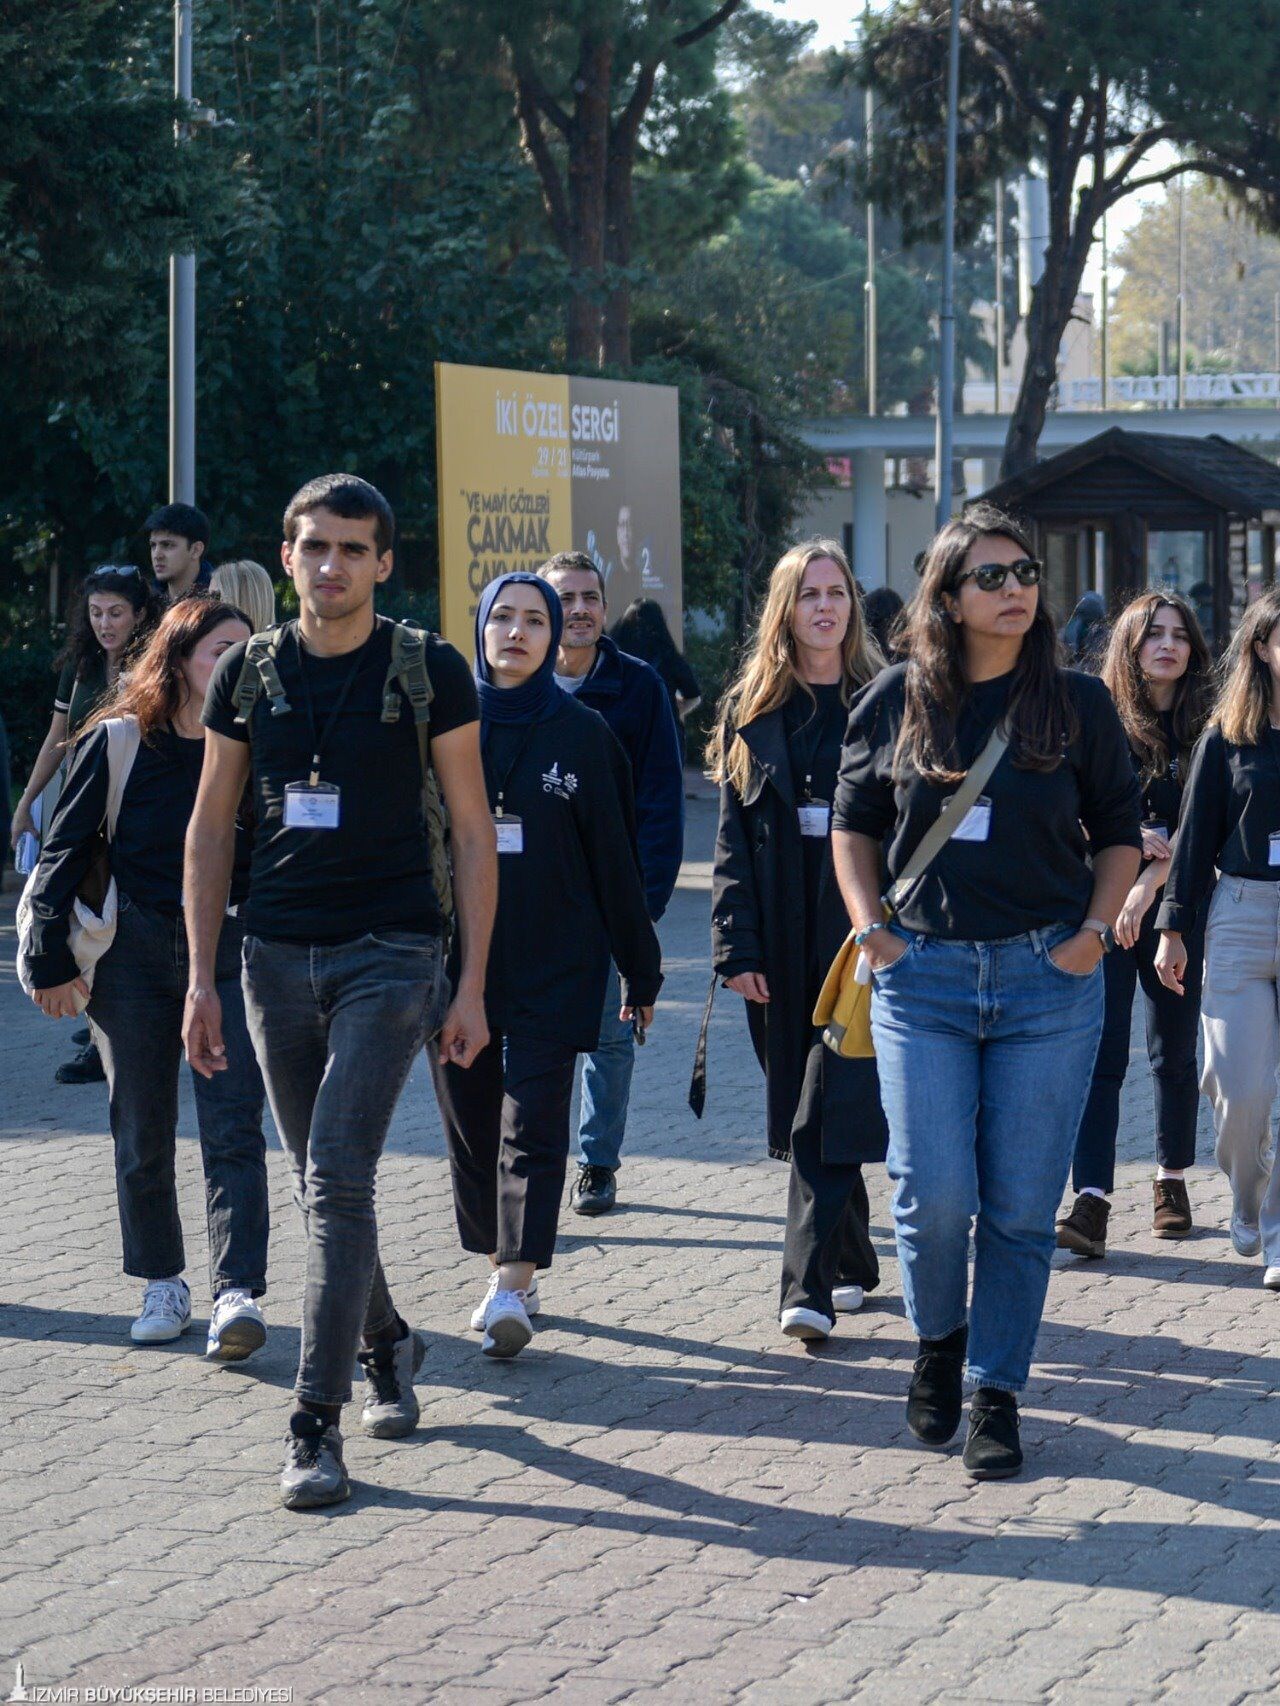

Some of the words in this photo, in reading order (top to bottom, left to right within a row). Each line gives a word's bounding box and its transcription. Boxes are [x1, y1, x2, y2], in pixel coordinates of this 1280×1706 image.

[496, 390, 518, 436] İKİ
[522, 393, 568, 439] ÖZEL
[571, 400, 619, 443] SERGİ
[509, 488, 550, 514] GÖZLERİ
[466, 515, 551, 558] ÇAKMAK
